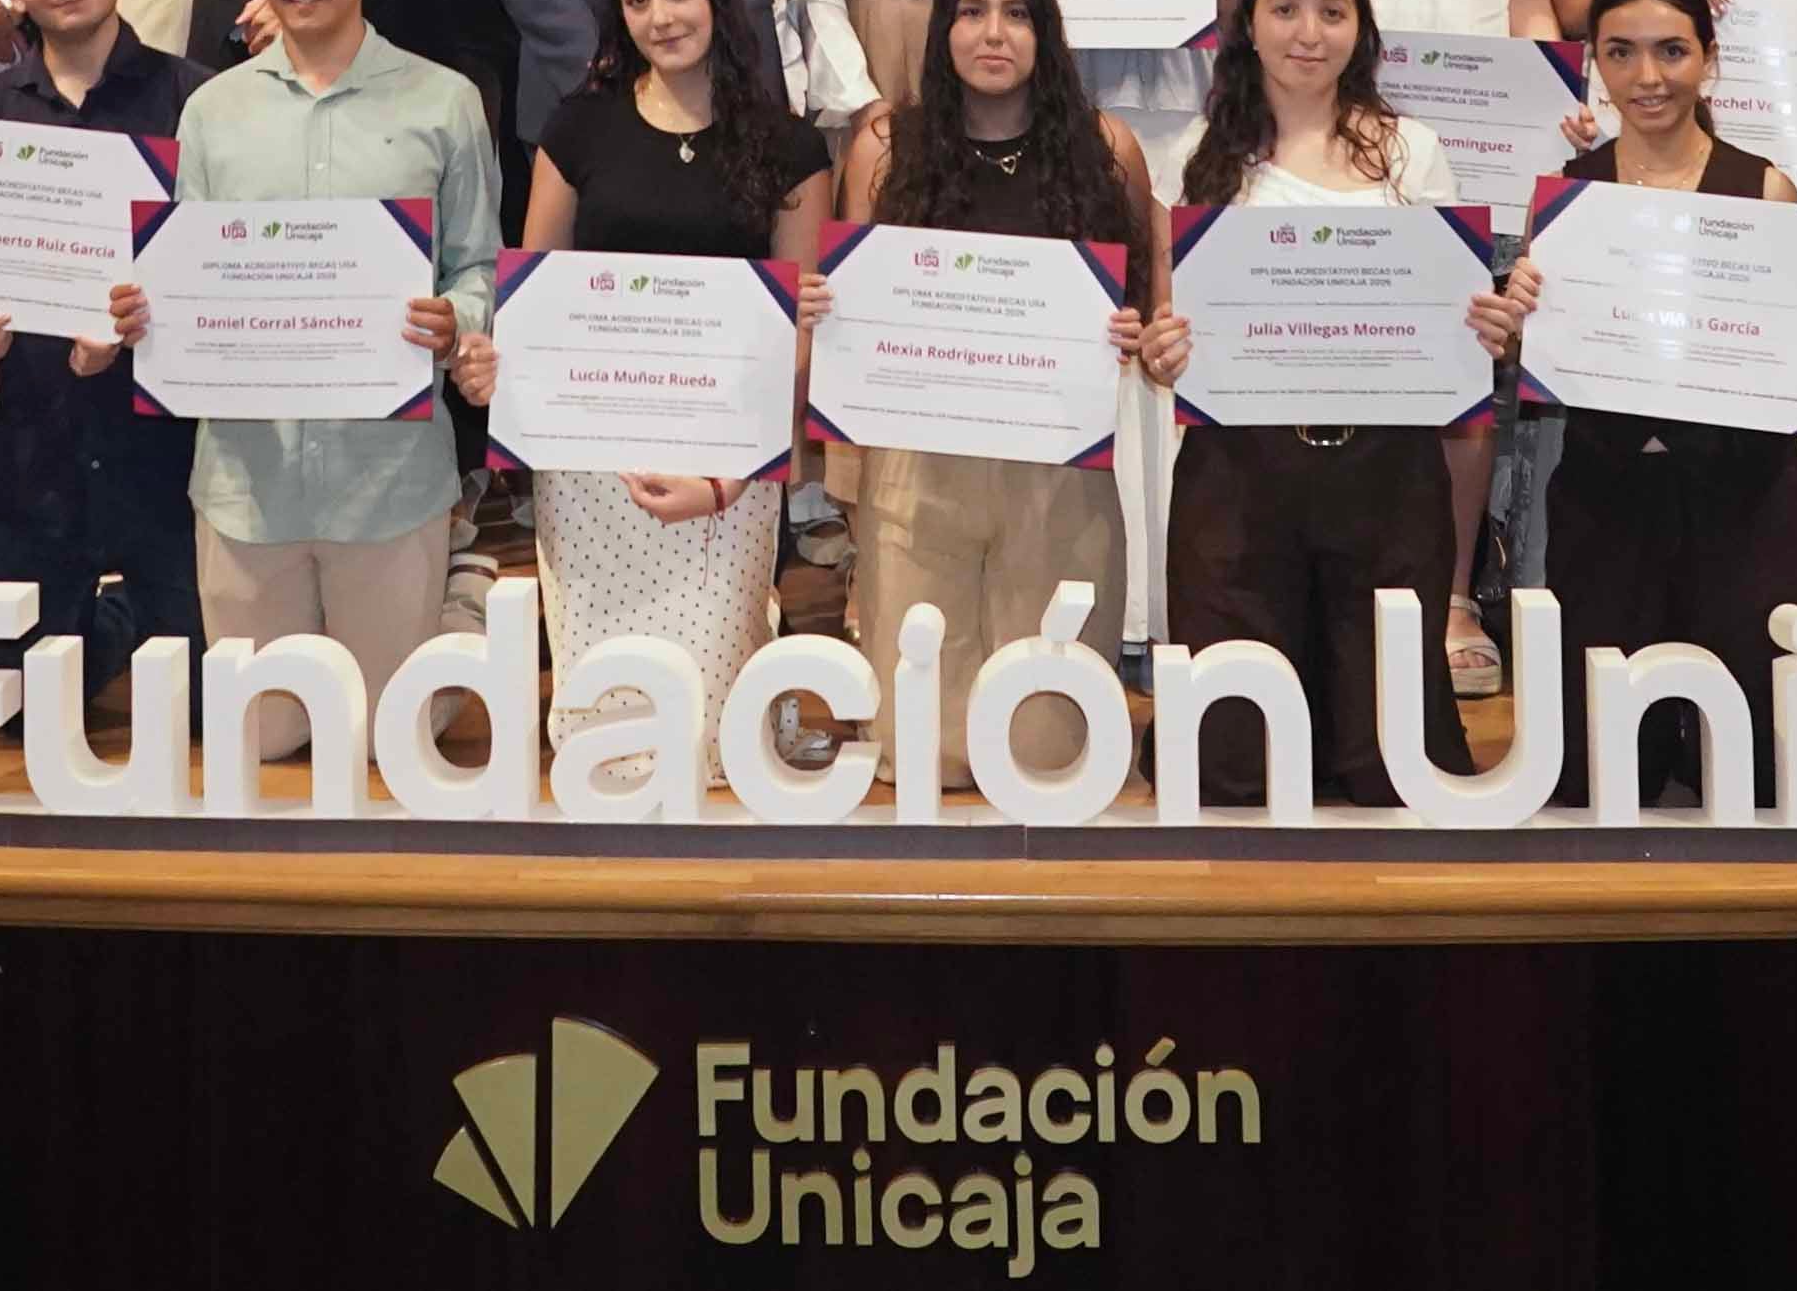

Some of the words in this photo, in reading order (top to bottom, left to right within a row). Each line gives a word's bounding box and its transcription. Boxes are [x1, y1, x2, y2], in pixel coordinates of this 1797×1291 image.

[1439, 136, 1515, 154] omínguez
[1336, 226, 1392, 237] Fundación
[1698, 217, 1755, 231] Fundación
[36, 238, 66, 252] Ruiz
[197, 317, 245, 330] Daniel
[249, 316, 296, 330] Corral
[300, 315, 363, 329] Sánchez
[1247, 322, 1283, 338] Julia
[1285, 322, 1349, 339] Villegas
[1353, 323, 1416, 336] Moreno
[1708, 318, 1760, 337] García
[876, 340, 922, 358] Alexia
[1007, 354, 1056, 369] Librán
[569, 368, 609, 383] Lucía
[614, 371, 665, 386] Muñoz
[669, 374, 717, 389] Rueda
[696, 1037, 1261, 1144] Fundación
[699, 1147, 1101, 1279] Unicaja
